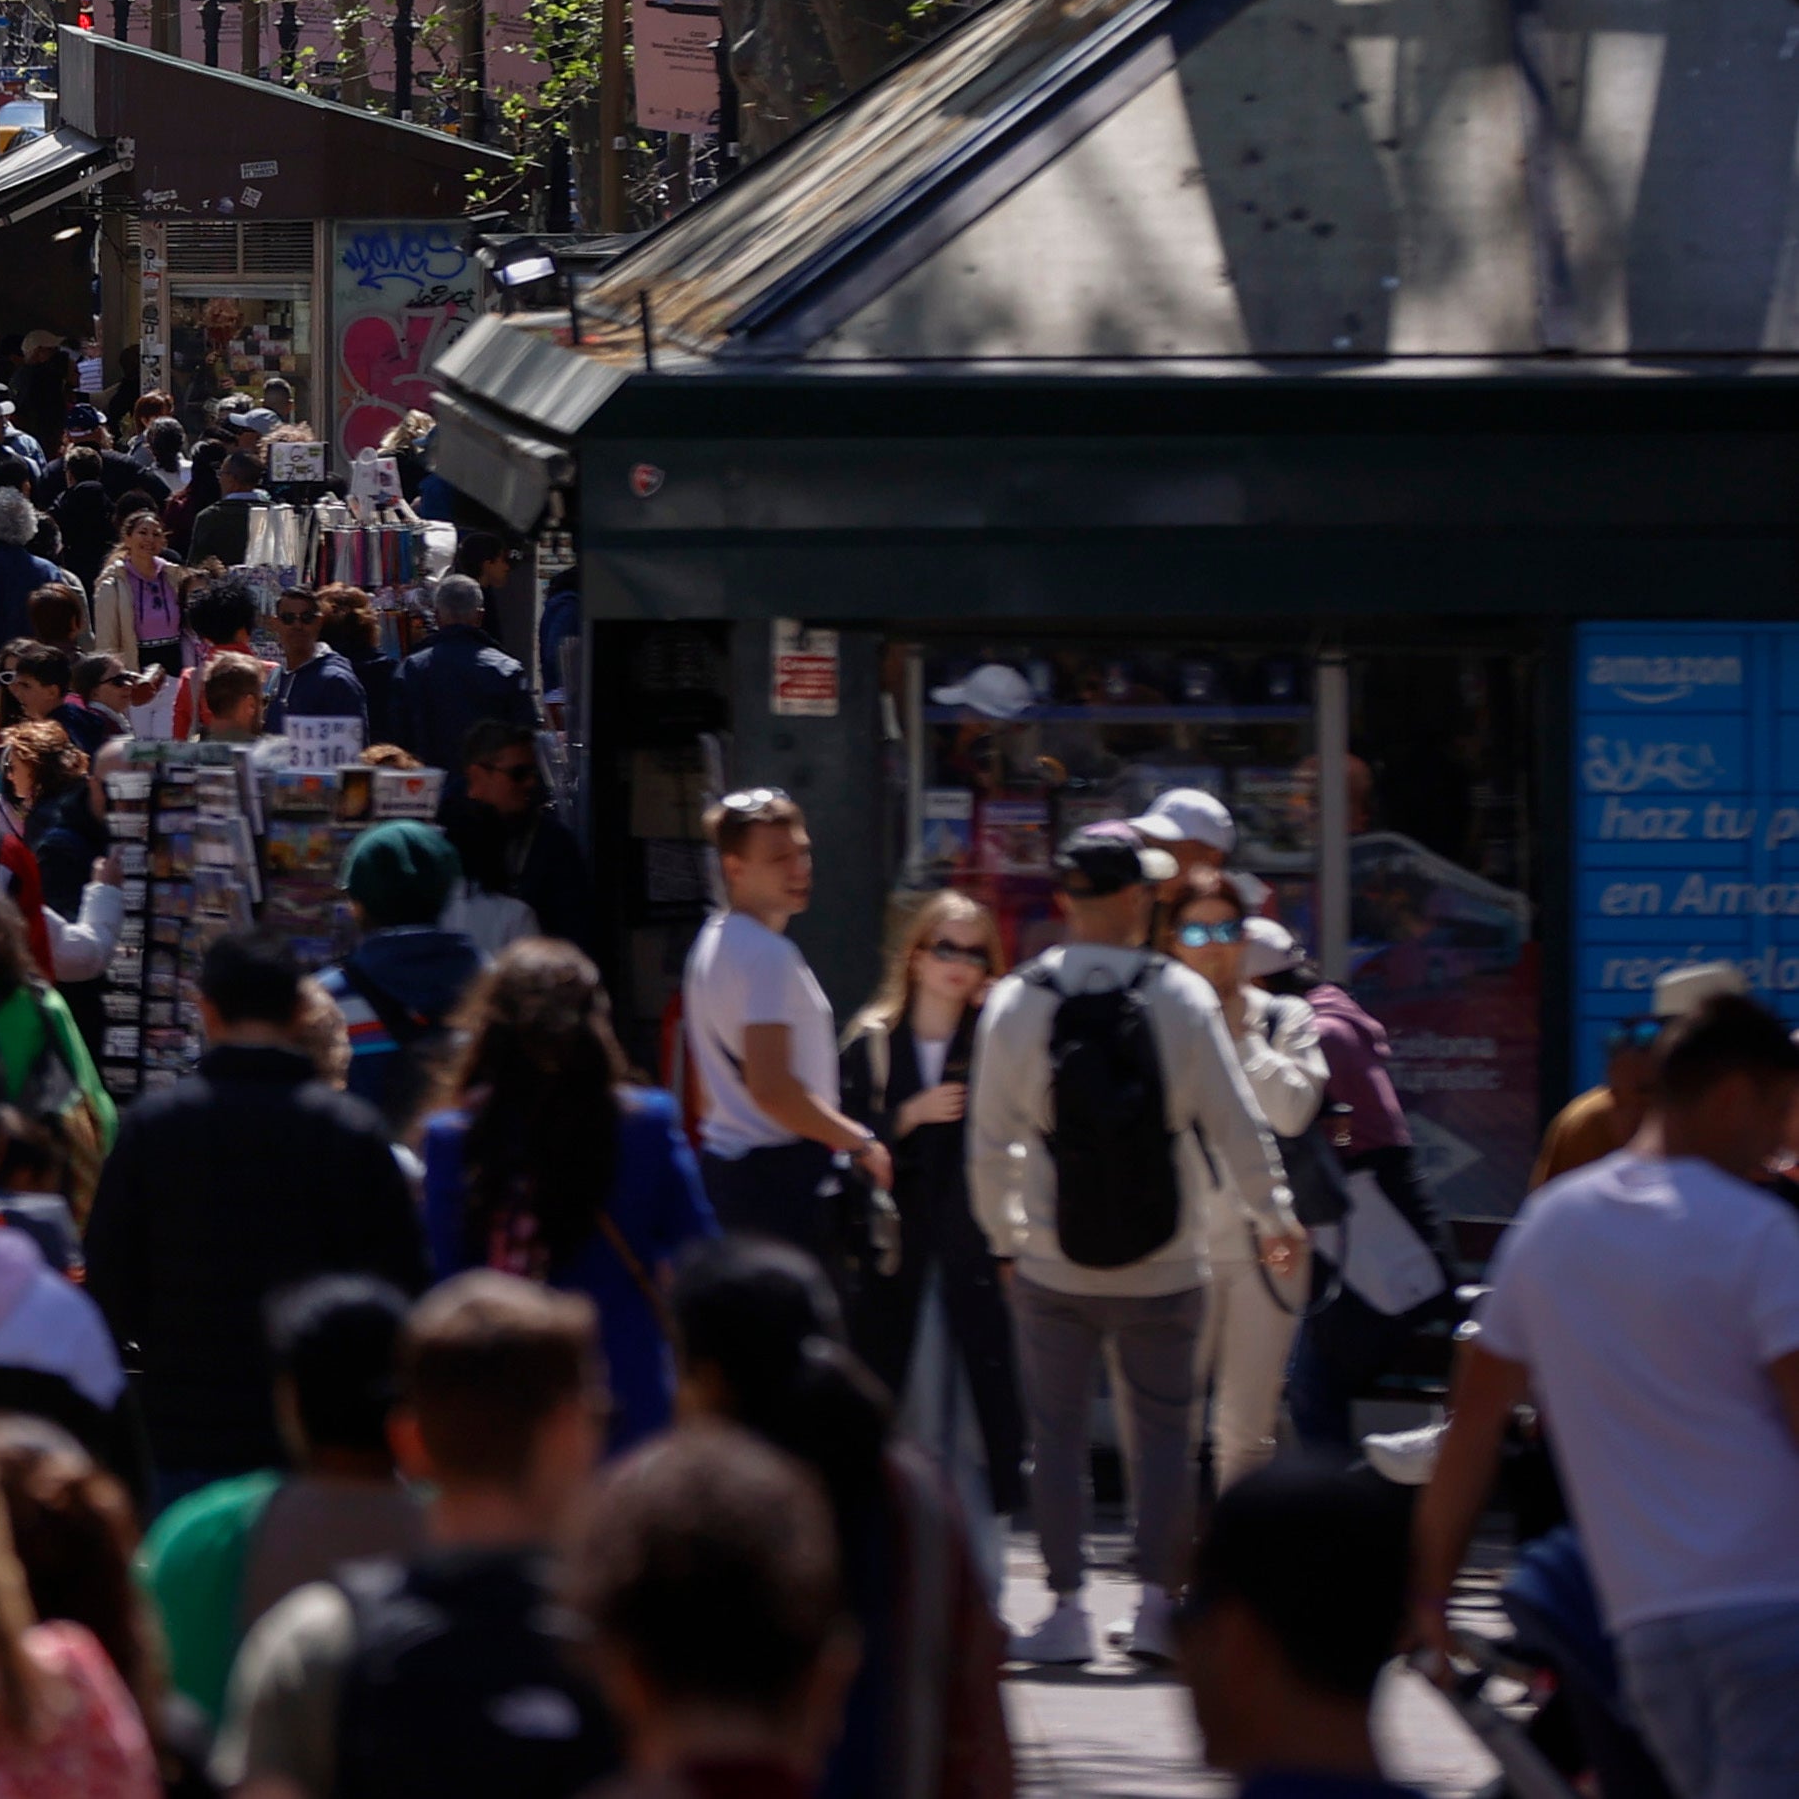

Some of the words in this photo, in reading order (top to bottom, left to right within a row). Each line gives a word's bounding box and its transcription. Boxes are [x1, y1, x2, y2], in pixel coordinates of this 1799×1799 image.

[1587, 655, 1742, 685] amazon
[1599, 795, 1693, 841] haz
[1702, 801, 1758, 841] tu
[1599, 882, 1662, 916] en
[1600, 944, 1799, 991] reelo
